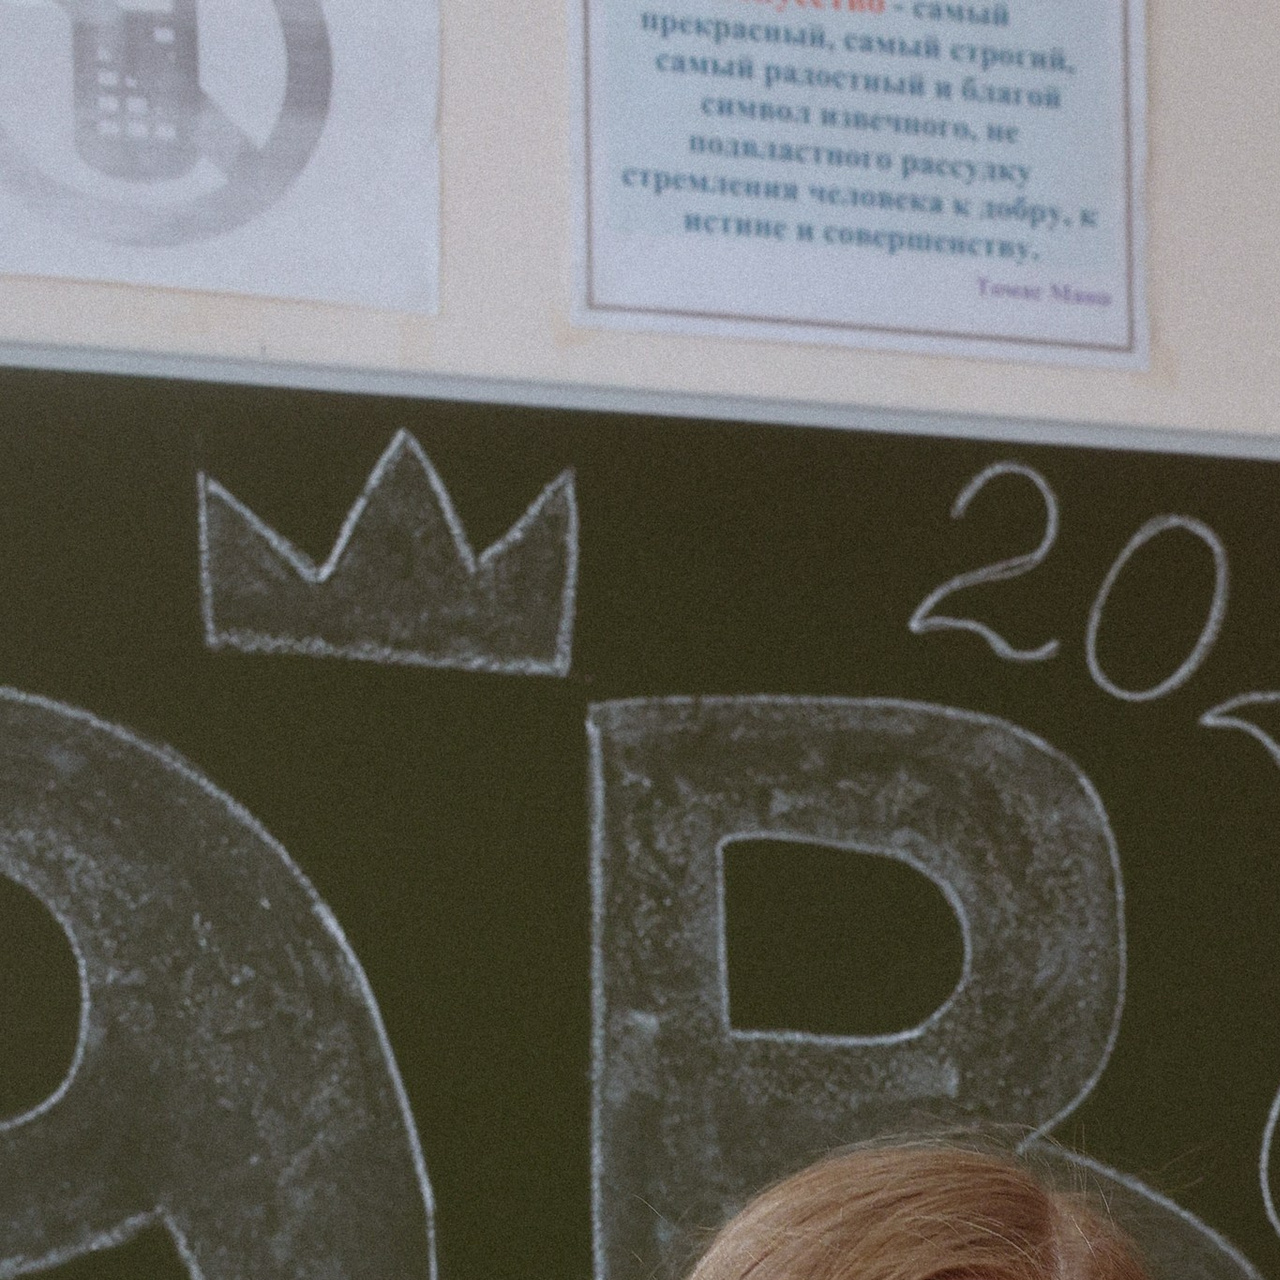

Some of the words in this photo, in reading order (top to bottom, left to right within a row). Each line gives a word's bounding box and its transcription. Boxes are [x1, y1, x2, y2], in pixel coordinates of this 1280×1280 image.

[912, 1, 1009, 26] самый
[640, 12, 836, 52] прекрасный,
[844, 33, 941, 58] самый
[950, 43, 1077, 75] строгий,
[655, 52, 753, 80] самый
[764, 61, 925, 96] радостный
[934, 80, 952, 98] и
[960, 75, 1061, 108] благой
[701, 96, 811, 124] символ
[820, 106, 978, 142] извечного,
[985, 122, 1019, 144] не
[689, 133, 893, 170] подвластного
[902, 153, 1030, 189] рассудку
[621, 164, 799, 200] стремления
[807, 183, 944, 214] человека
[952, 197, 970, 218] к
[978, 195, 1073, 231] добру,
[1078, 205, 1099, 228] к
[683, 211, 787, 241] истине
[795, 221, 814, 244] и
[822, 224, 1041, 266] совершенству.
